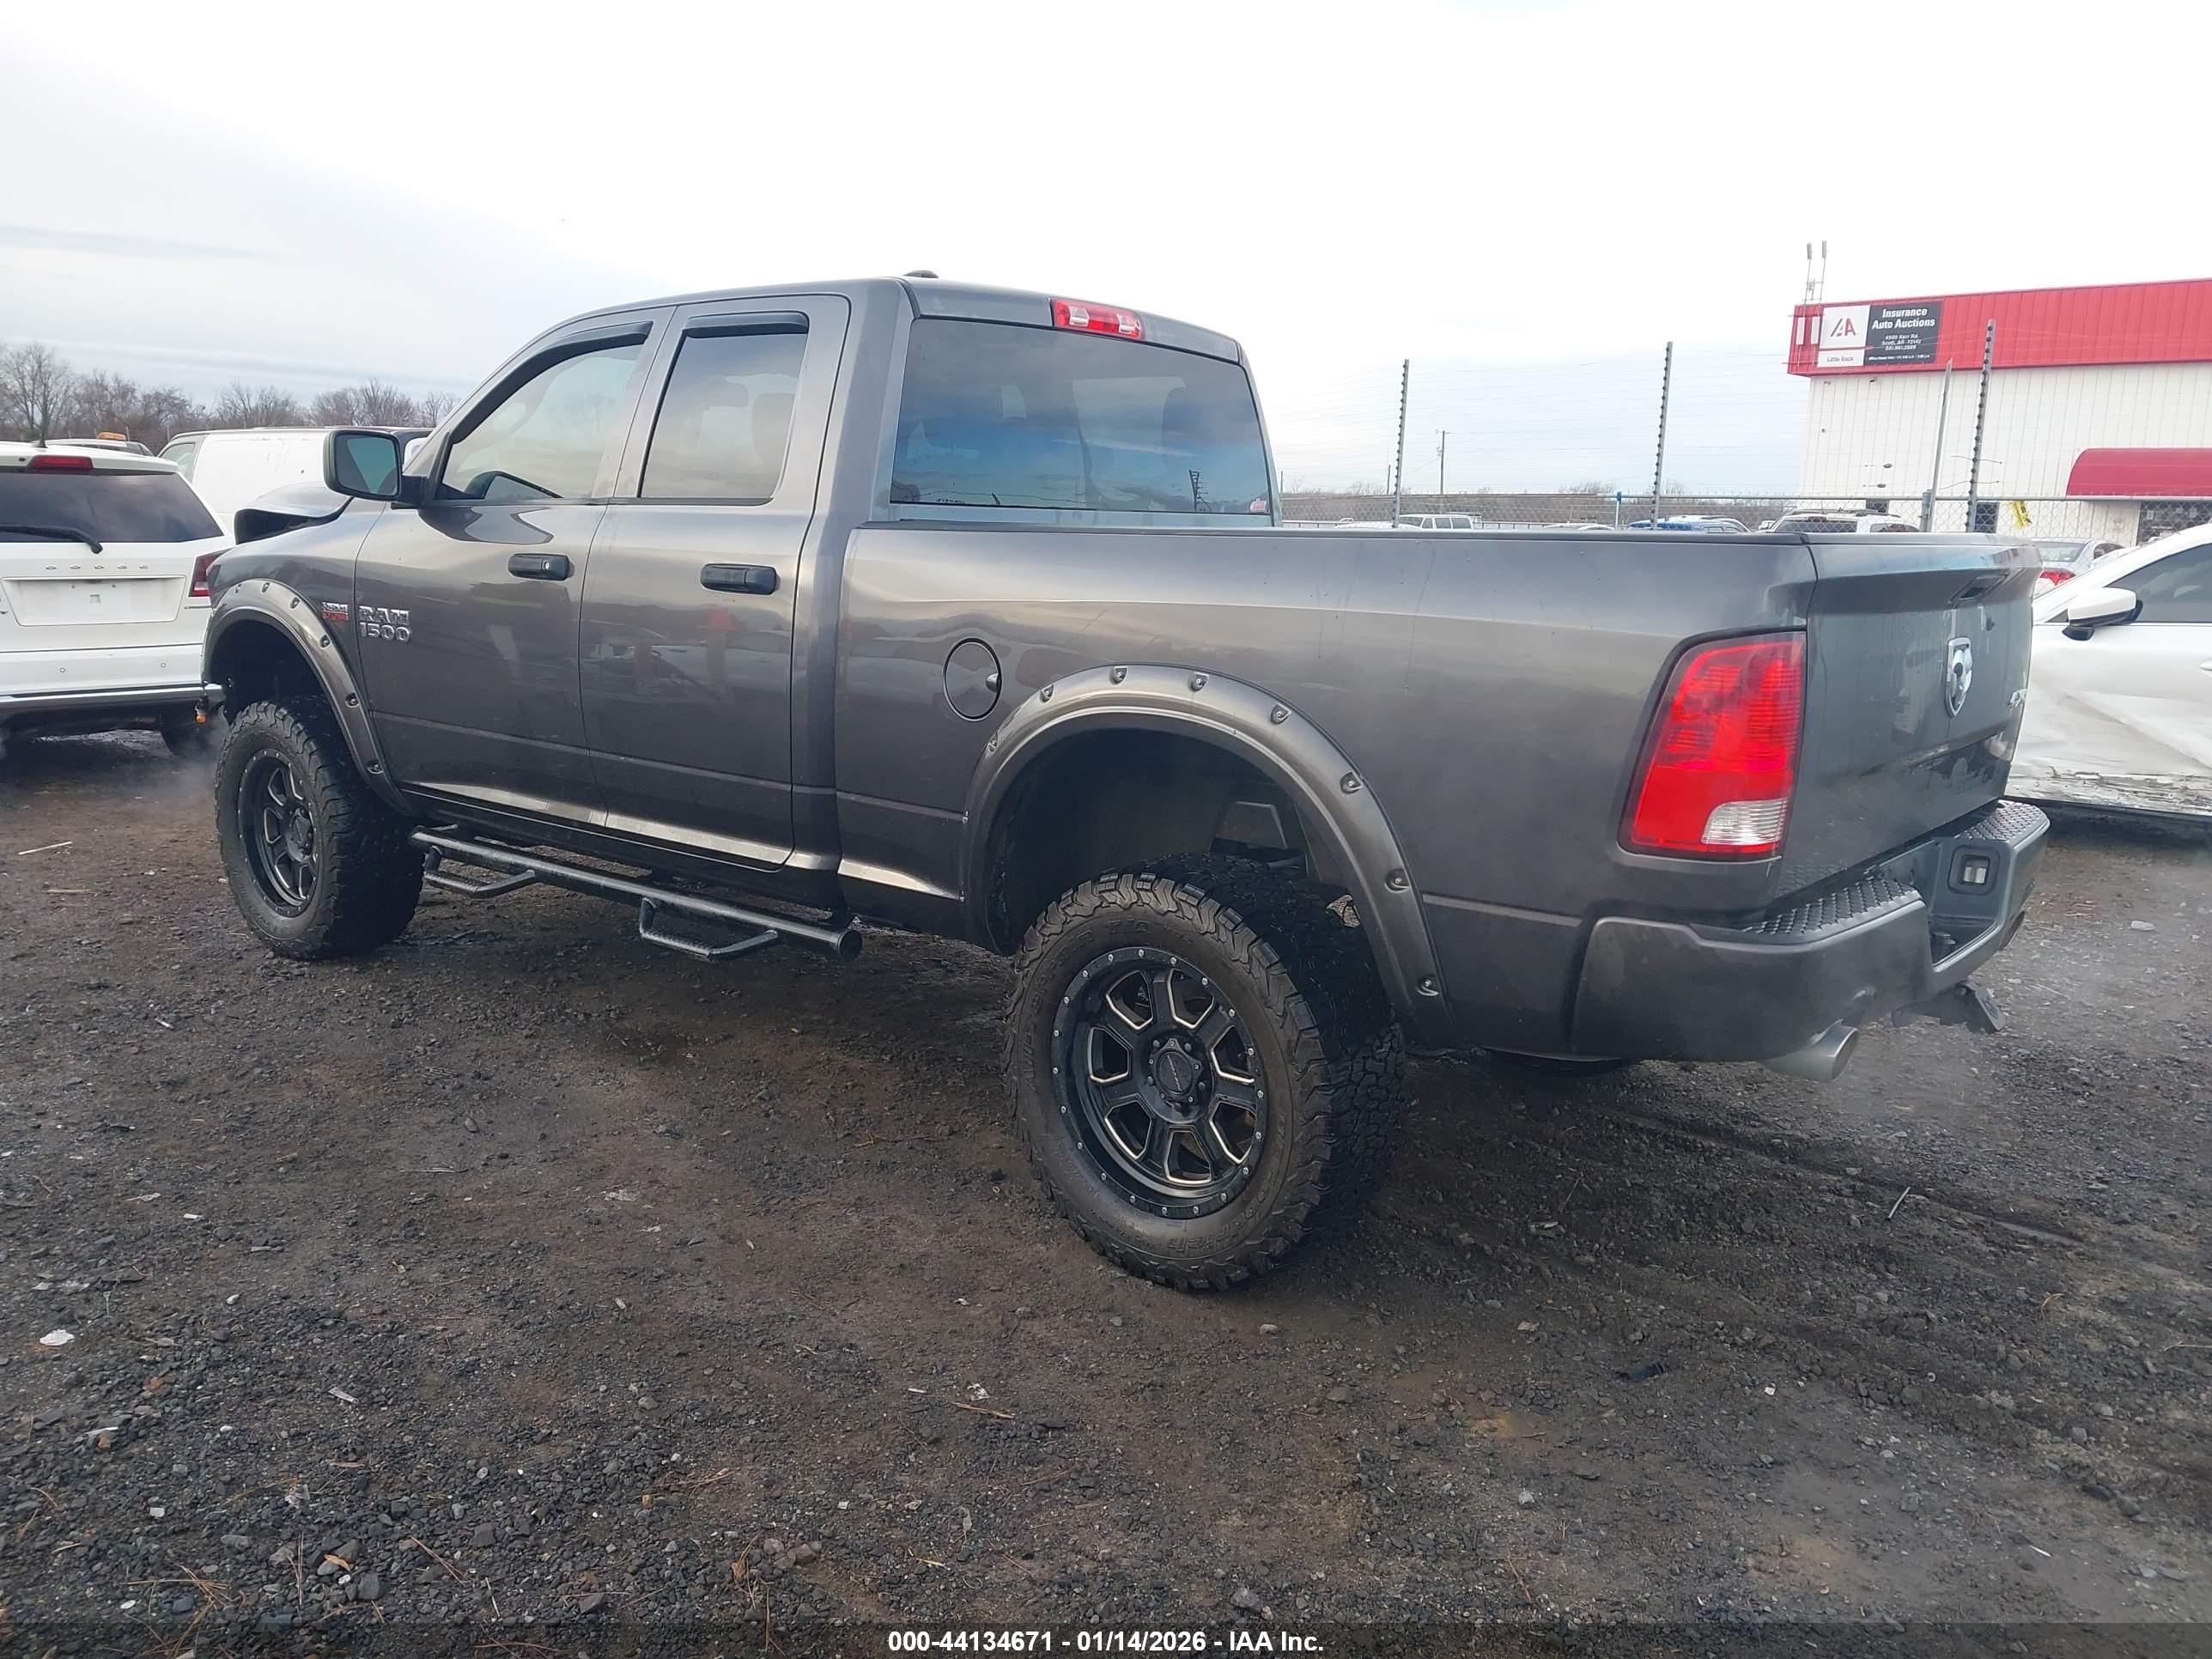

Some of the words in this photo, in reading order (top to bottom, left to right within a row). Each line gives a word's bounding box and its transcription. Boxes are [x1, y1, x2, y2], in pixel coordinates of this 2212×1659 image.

[1881, 308, 1928, 318] Insurance
[1872, 319, 1893, 330] Auto
[1894, 318, 1936, 329] Auctions
[359, 605, 411, 626] RAM
[359, 622, 412, 643] 1500
